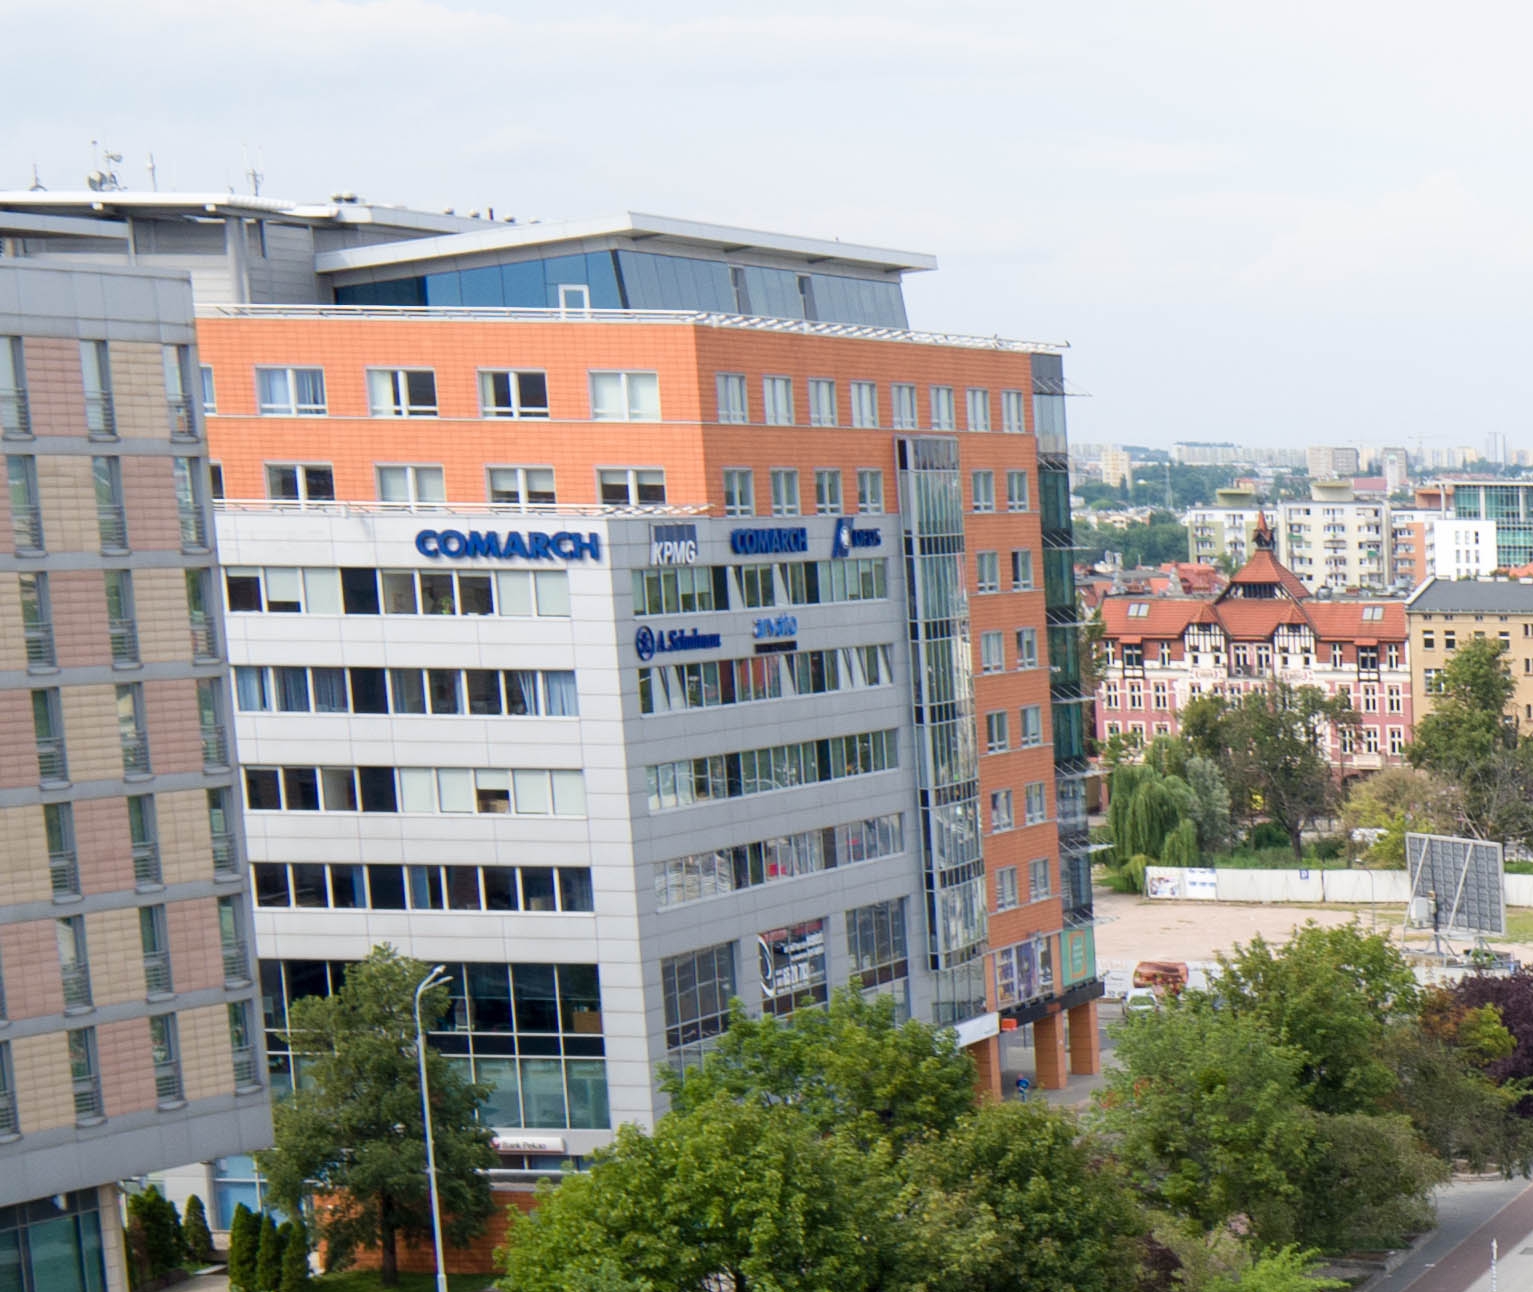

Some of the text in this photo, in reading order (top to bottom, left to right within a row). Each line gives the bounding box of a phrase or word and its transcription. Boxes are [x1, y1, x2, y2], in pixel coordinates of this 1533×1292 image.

[415, 529, 600, 561] COMARCH
[653, 540, 697, 564] KPMG
[731, 527, 808, 554] COMARCH
